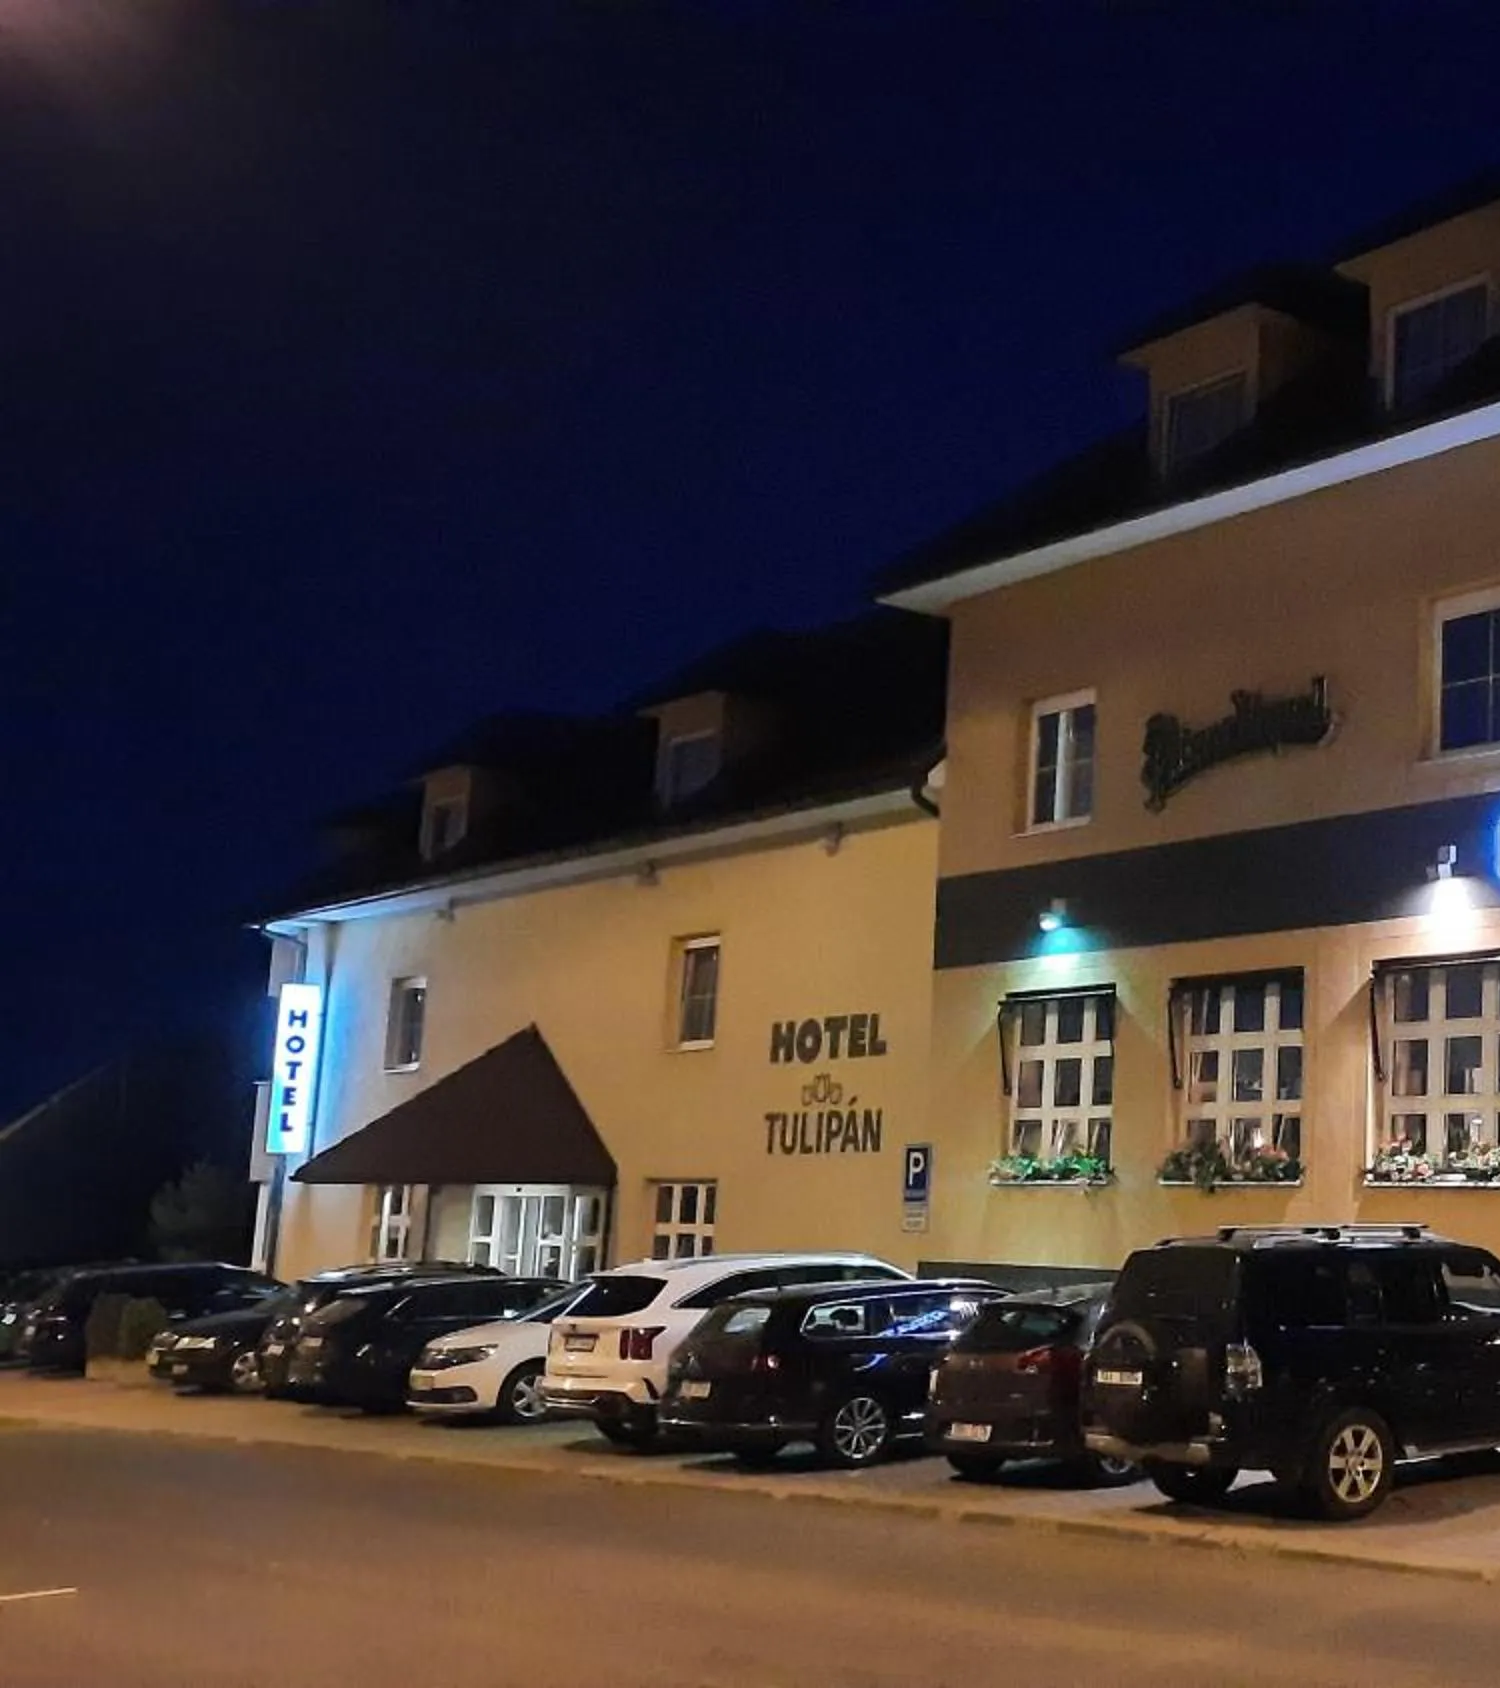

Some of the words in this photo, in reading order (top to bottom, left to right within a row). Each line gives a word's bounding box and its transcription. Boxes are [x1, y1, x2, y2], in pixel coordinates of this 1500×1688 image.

[769, 1013, 887, 1064] HOTEL
[279, 1009, 308, 1132] HOTEL
[764, 1096, 882, 1155] TULIPÁN
[909, 1151, 925, 1186] P
